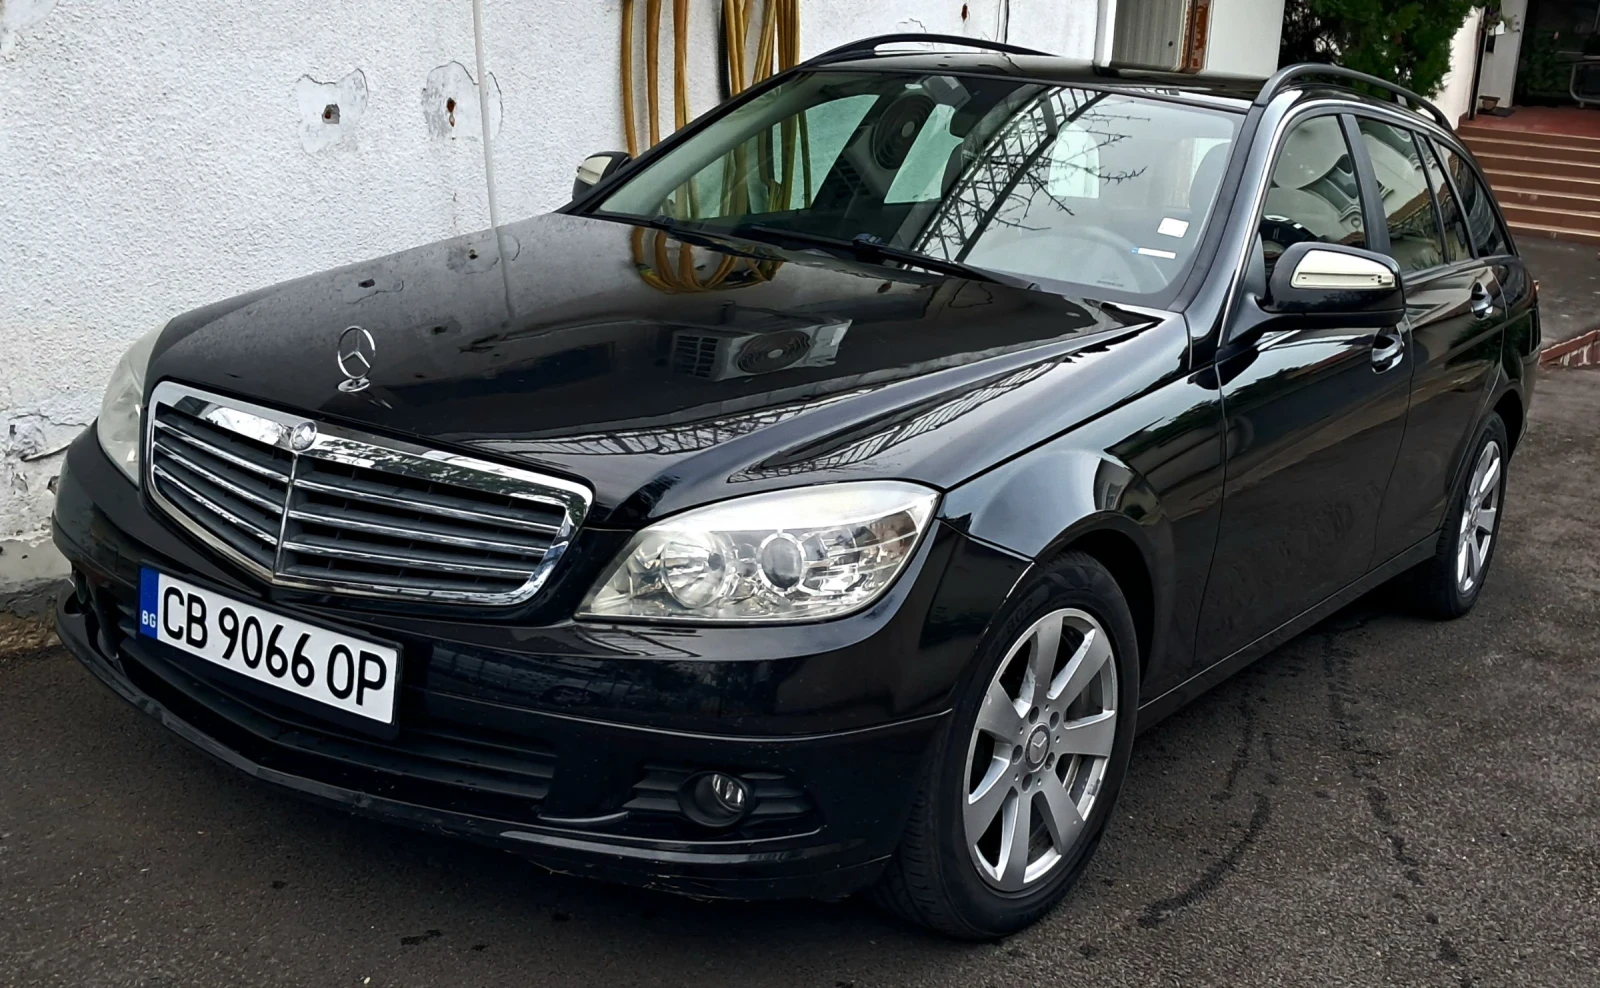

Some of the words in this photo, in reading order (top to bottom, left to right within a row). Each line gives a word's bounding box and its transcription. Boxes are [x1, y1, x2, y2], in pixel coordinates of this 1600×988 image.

[141, 610, 156, 628] BG
[163, 586, 208, 649] CB
[218, 607, 315, 687] 9066
[326, 643, 387, 706] OP
